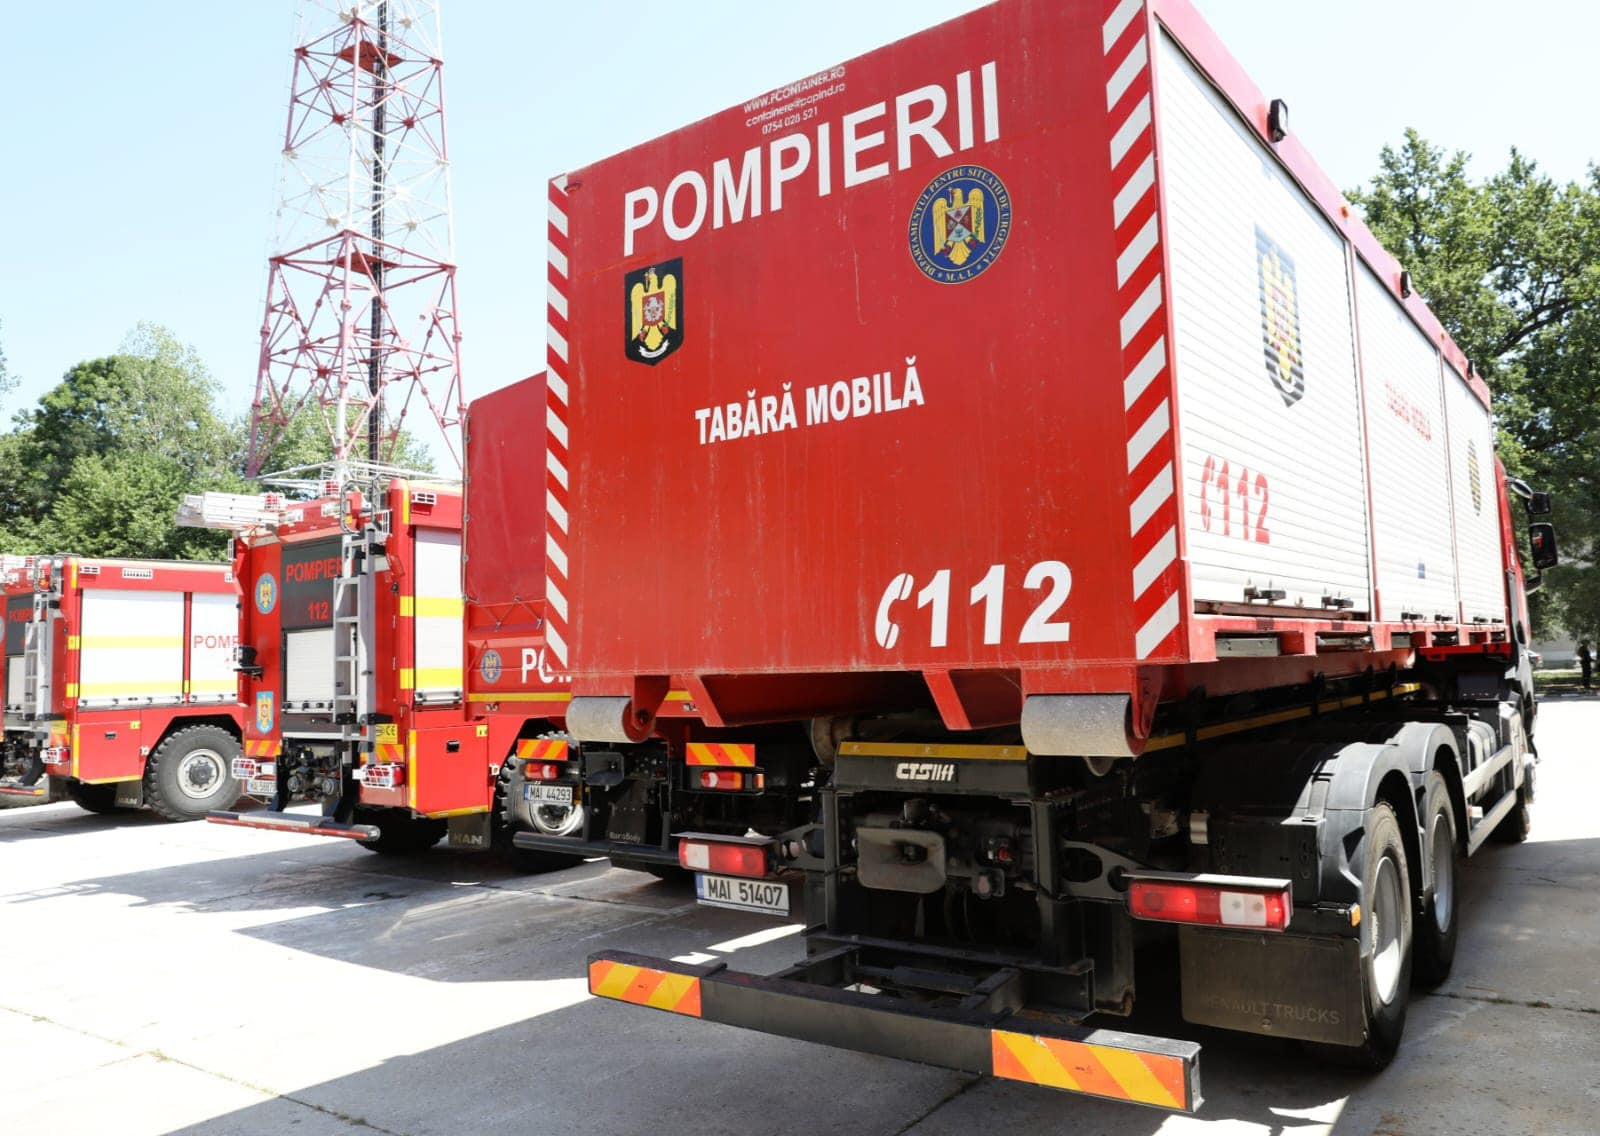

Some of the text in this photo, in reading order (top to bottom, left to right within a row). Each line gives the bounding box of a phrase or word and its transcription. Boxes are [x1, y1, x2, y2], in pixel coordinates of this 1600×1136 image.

[762, 120, 783, 135] 0754
[802, 106, 818, 121] 521
[623, 61, 1000, 257] POMPIERII
[929, 168, 966, 193] PENTRU
[695, 355, 925, 445] TABĂRĂ MOBILĂ
[1216, 459, 1270, 545] 112
[308, 601, 330, 620] 112
[917, 560, 1073, 648] 112
[530, 788, 571, 801] MAI 44293
[707, 878, 783, 906] MAI 51407
[1272, 1003, 1341, 1024] TRUCKS
